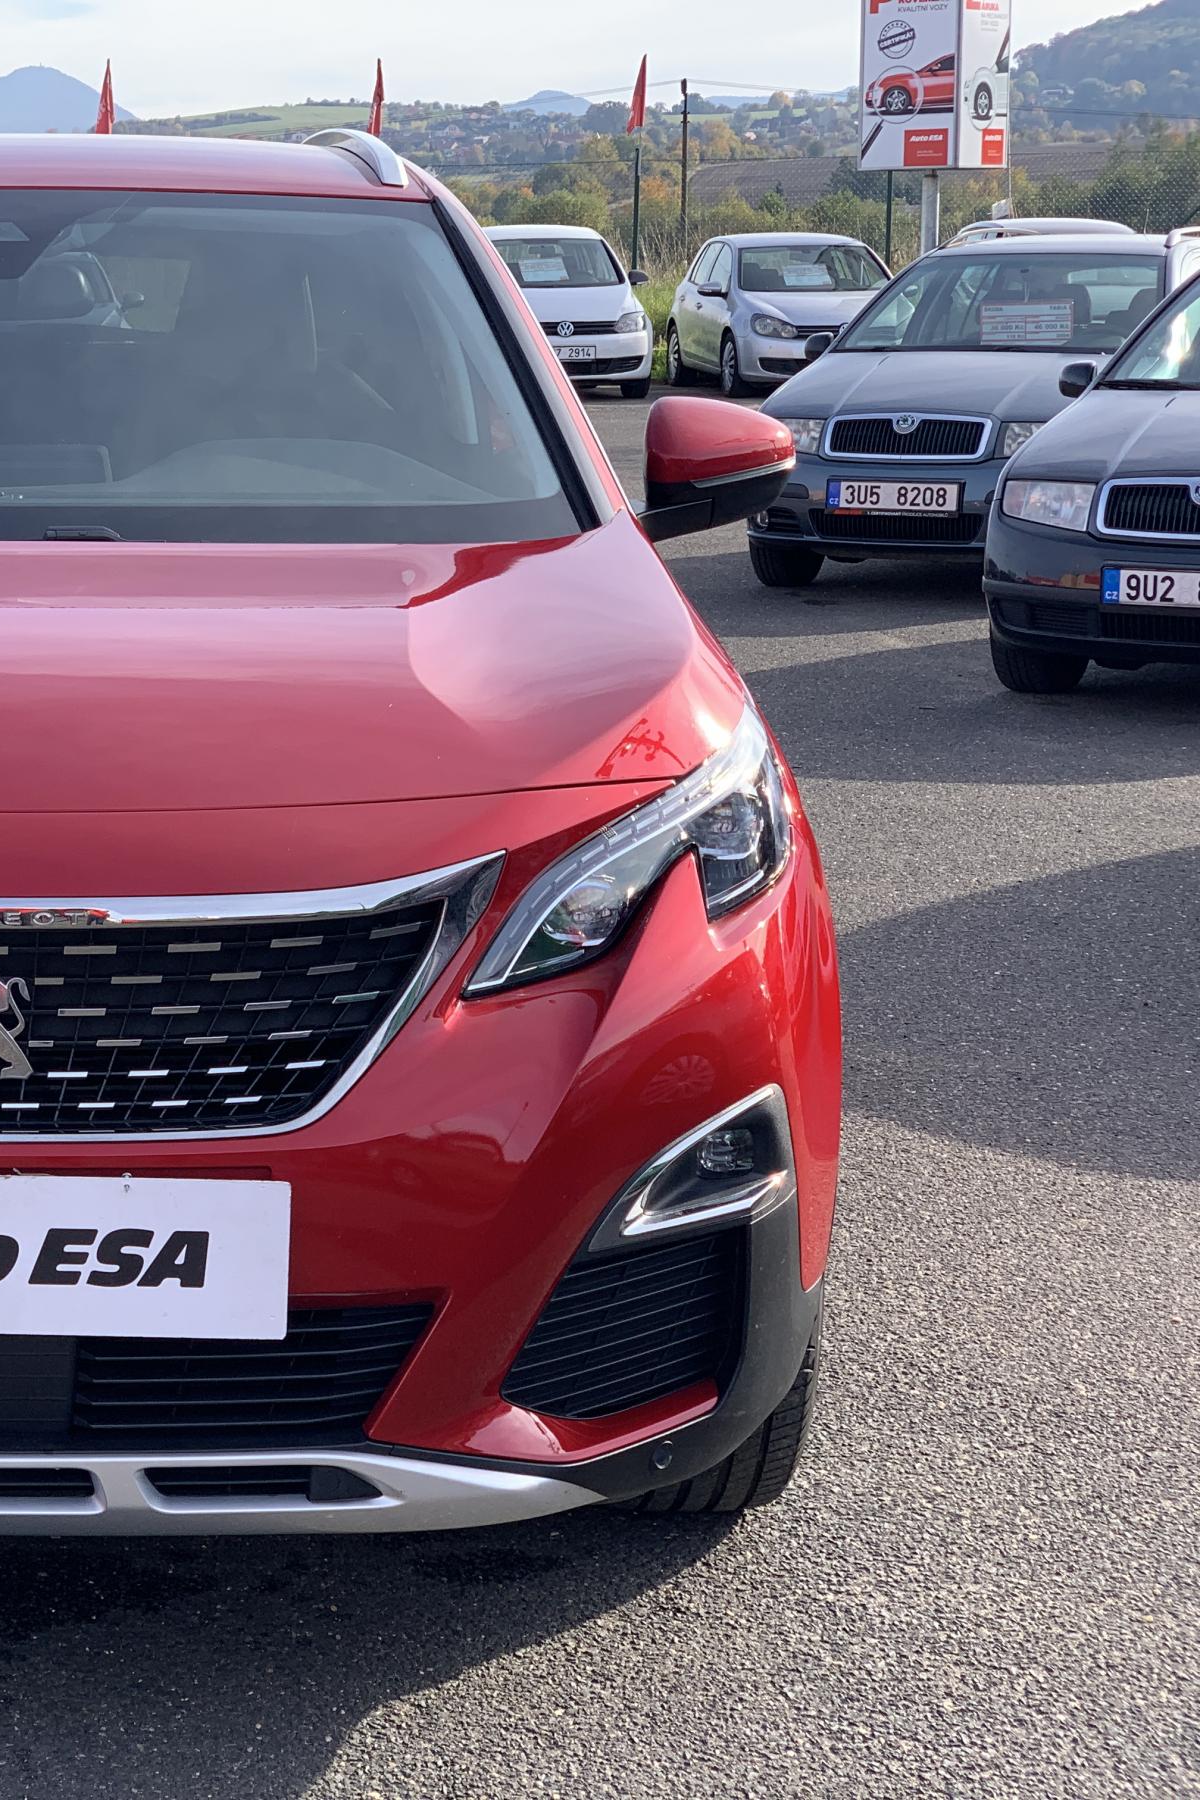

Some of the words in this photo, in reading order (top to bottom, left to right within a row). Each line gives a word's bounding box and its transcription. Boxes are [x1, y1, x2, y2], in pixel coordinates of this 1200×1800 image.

[897, 4, 928, 12] KVALITNÍ
[568, 348, 591, 358] 2914
[844, 484, 881, 506] 3U5
[896, 485, 947, 507] 8208
[829, 497, 839, 505] CZ
[1125, 574, 1175, 603] 9U2
[1105, 591, 1118, 600] CZ
[27, 1227, 210, 1289] ESA
